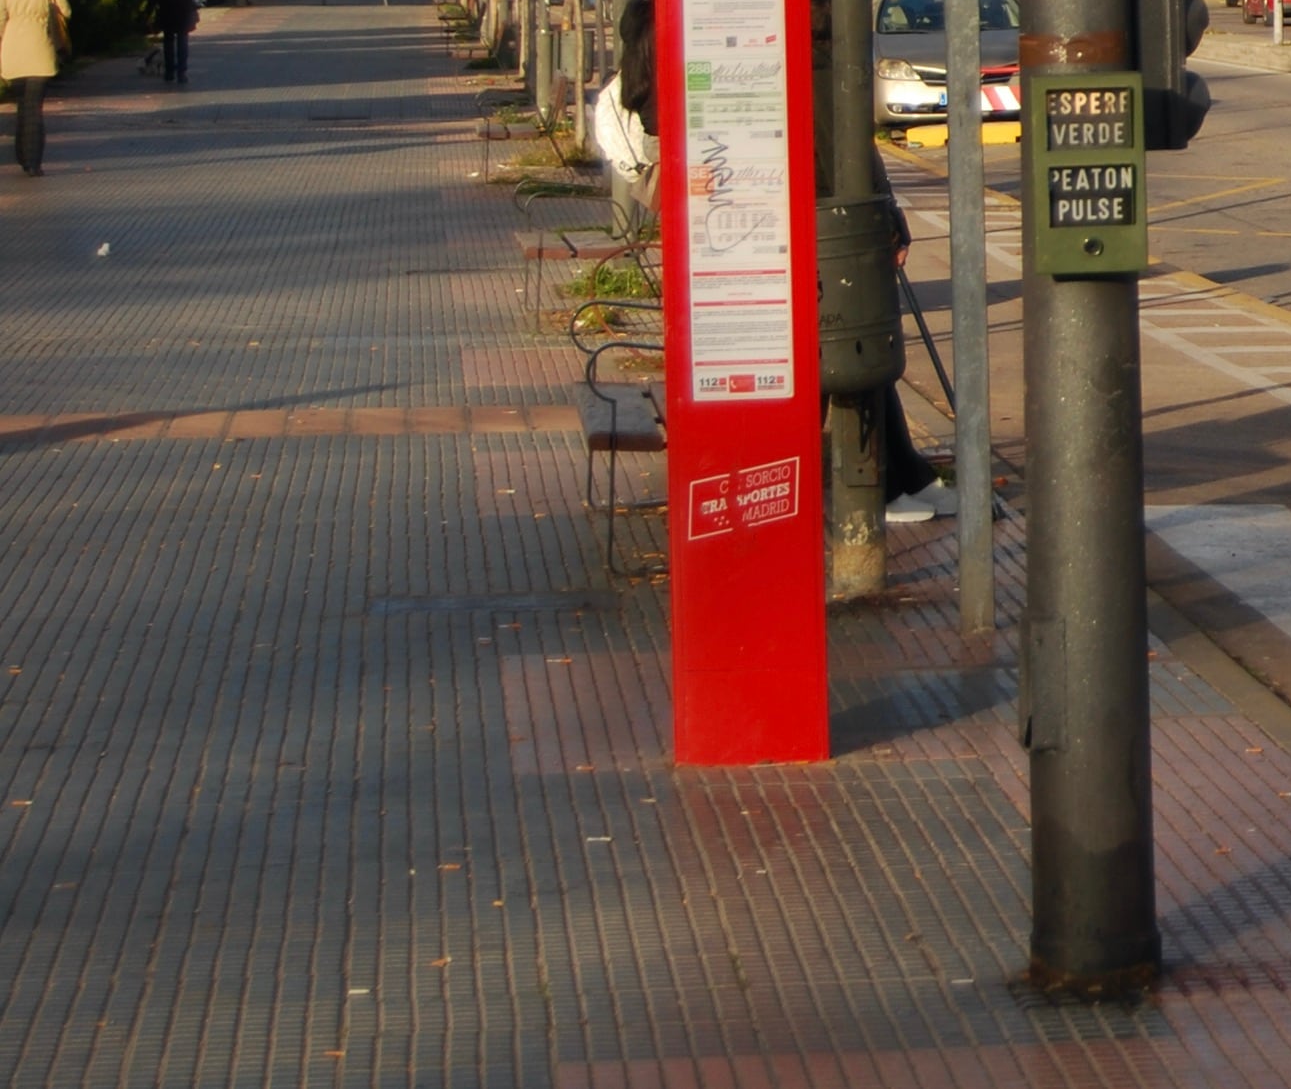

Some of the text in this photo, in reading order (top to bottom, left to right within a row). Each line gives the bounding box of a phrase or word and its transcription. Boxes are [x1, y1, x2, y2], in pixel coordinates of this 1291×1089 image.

[1052, 122, 1125, 146] VERDE
[1058, 197, 1124, 221] PULSE
[742, 498, 790, 522] MADRID
